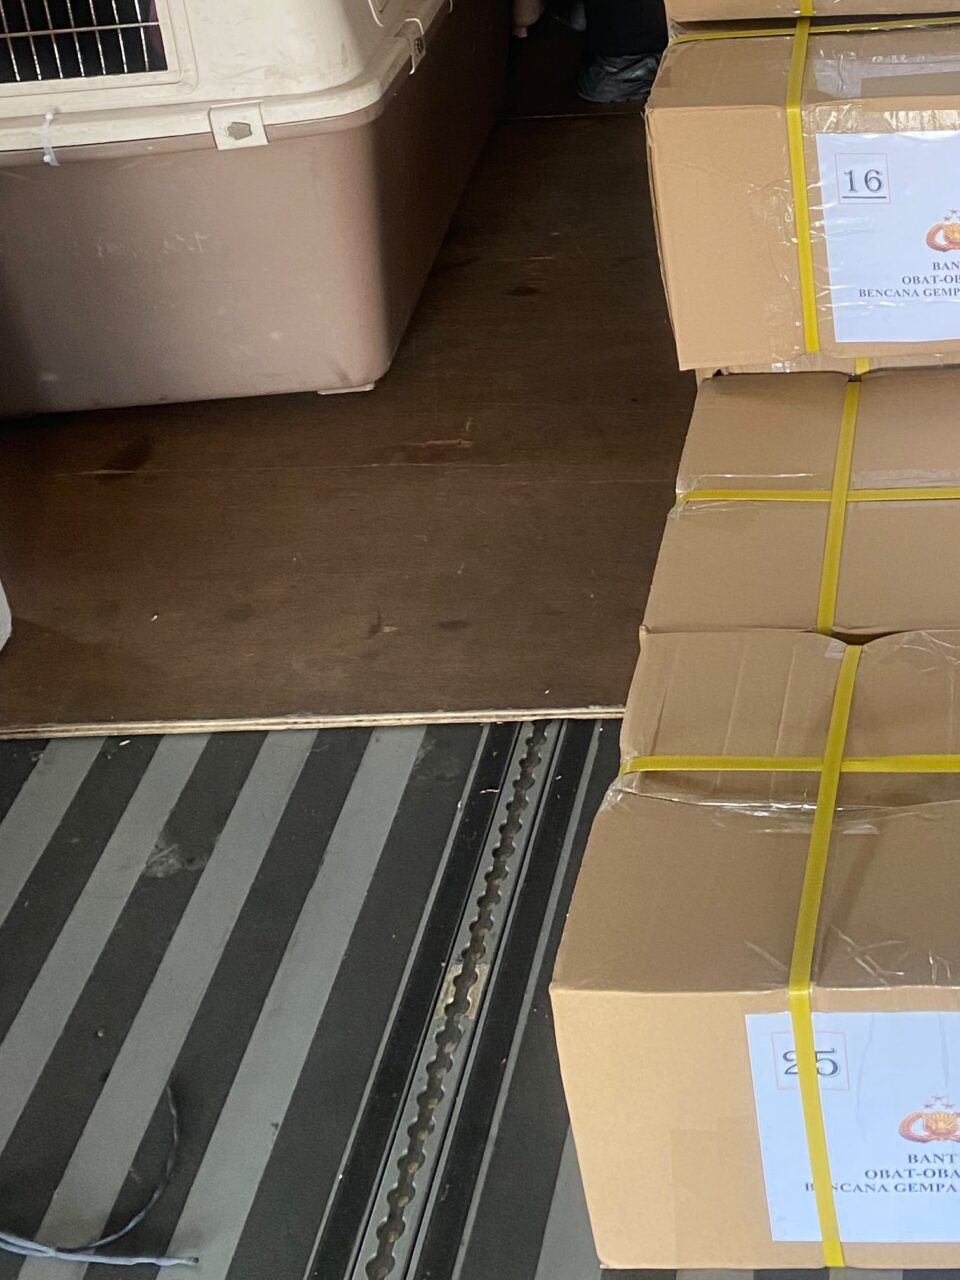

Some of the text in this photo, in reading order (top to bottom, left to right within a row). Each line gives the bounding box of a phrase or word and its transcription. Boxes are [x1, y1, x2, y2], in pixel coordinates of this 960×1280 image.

[843, 169, 884, 194] 16
[858, 287, 920, 299] BENCANA
[782, 1047, 840, 1077] 25
[804, 1183, 889, 1194] BNCANA
[893, 1182, 957, 1194] GEMPA
